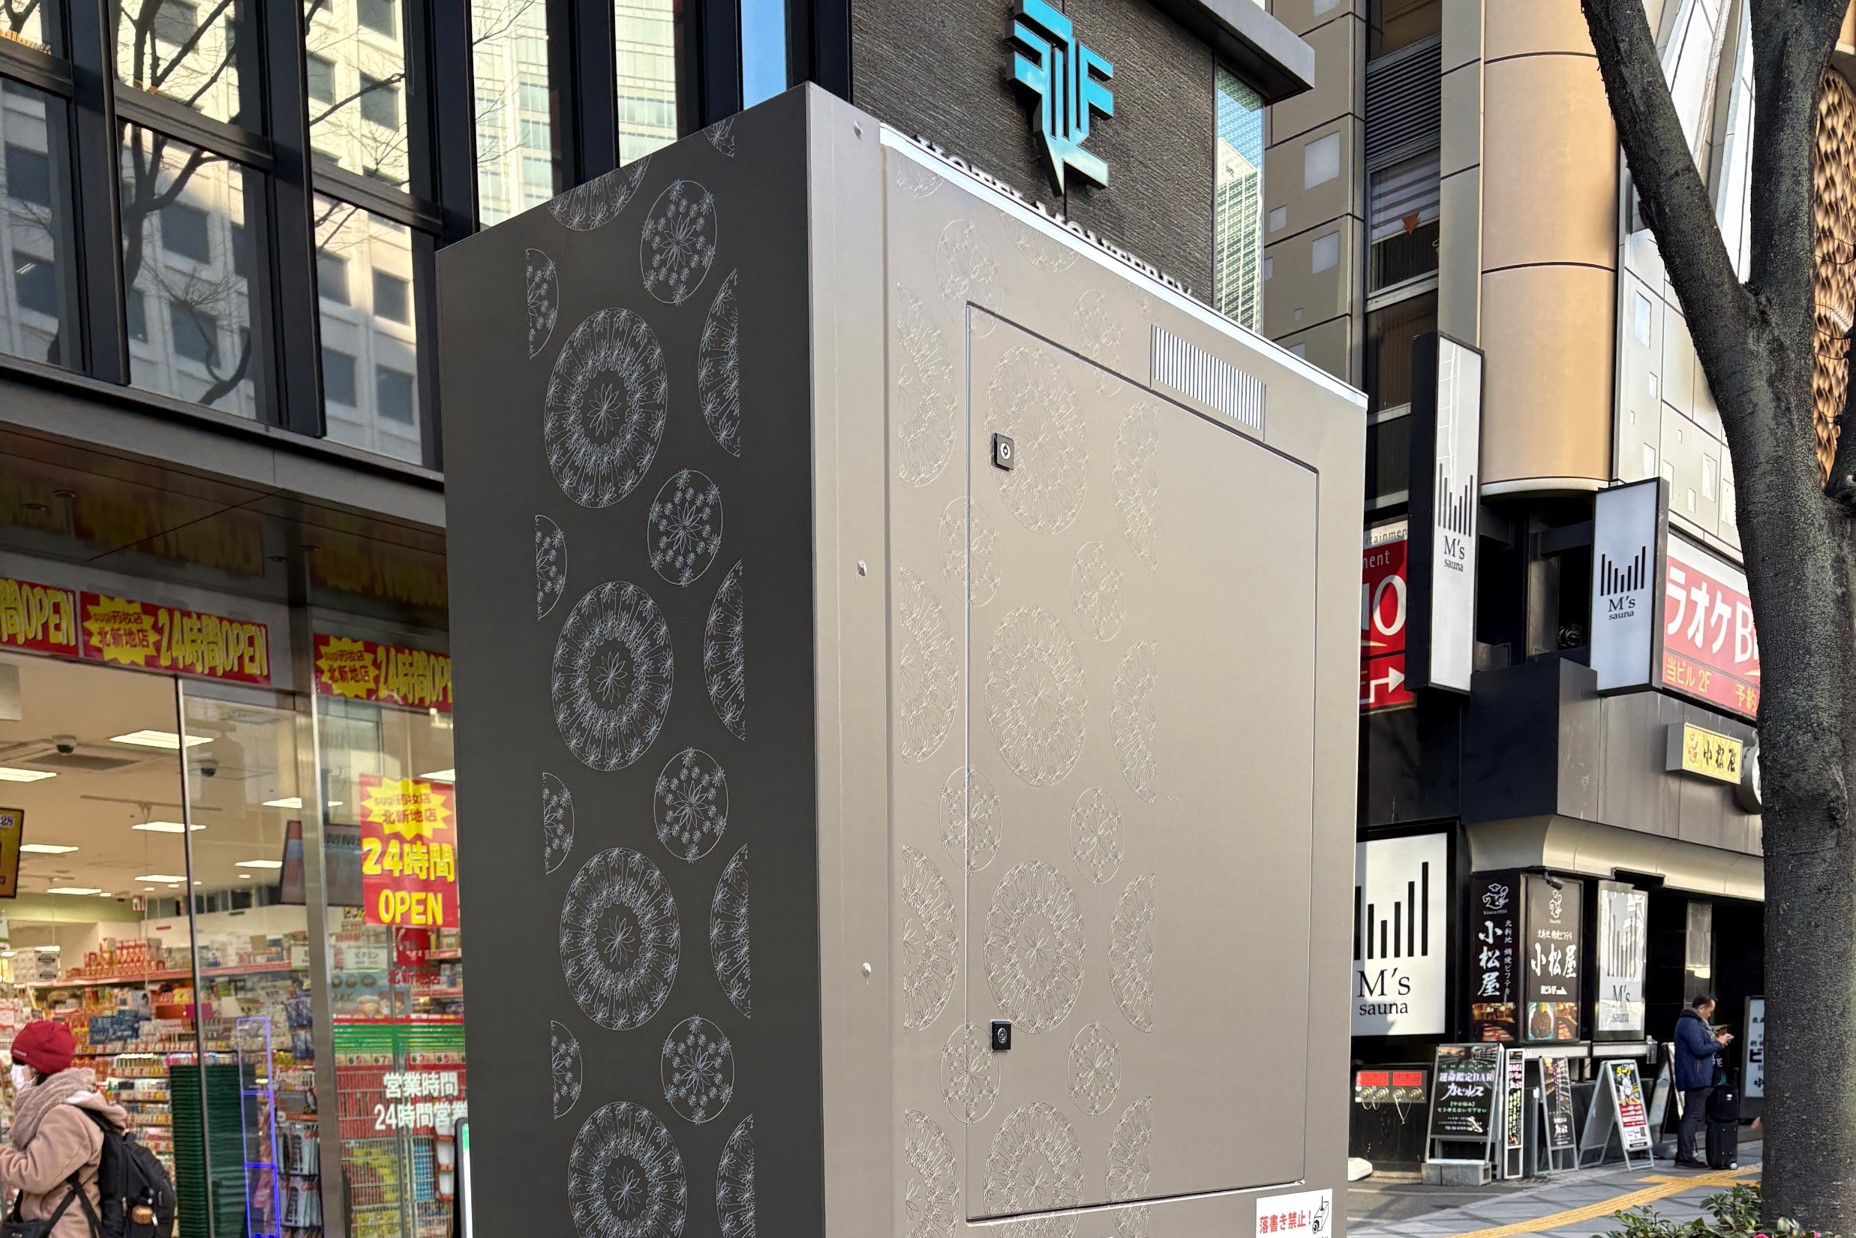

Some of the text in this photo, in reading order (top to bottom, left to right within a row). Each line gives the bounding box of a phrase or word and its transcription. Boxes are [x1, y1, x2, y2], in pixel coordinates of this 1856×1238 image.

[1444, 535, 1465, 560] M's
[1444, 559, 1464, 573] sauna
[1608, 595, 1636, 613] M's
[1608, 609, 1635, 621] sauna
[1666, 565, 1760, 664] ラオケB
[1667, 656, 1712, 693] 当ビル 2F
[382, 808, 438, 825] 北新地店
[362, 837, 455, 882] 24時間
[378, 888, 444, 926] OPEN
[1503, 919, 1513, 944] 北新地
[1477, 920, 1503, 997] 小松屋
[1531, 942, 1577, 979] 小松屋
[1357, 967, 1411, 998] M's
[1359, 1001, 1409, 1016] sauna
[383, 1070, 458, 1099] 営業時間
